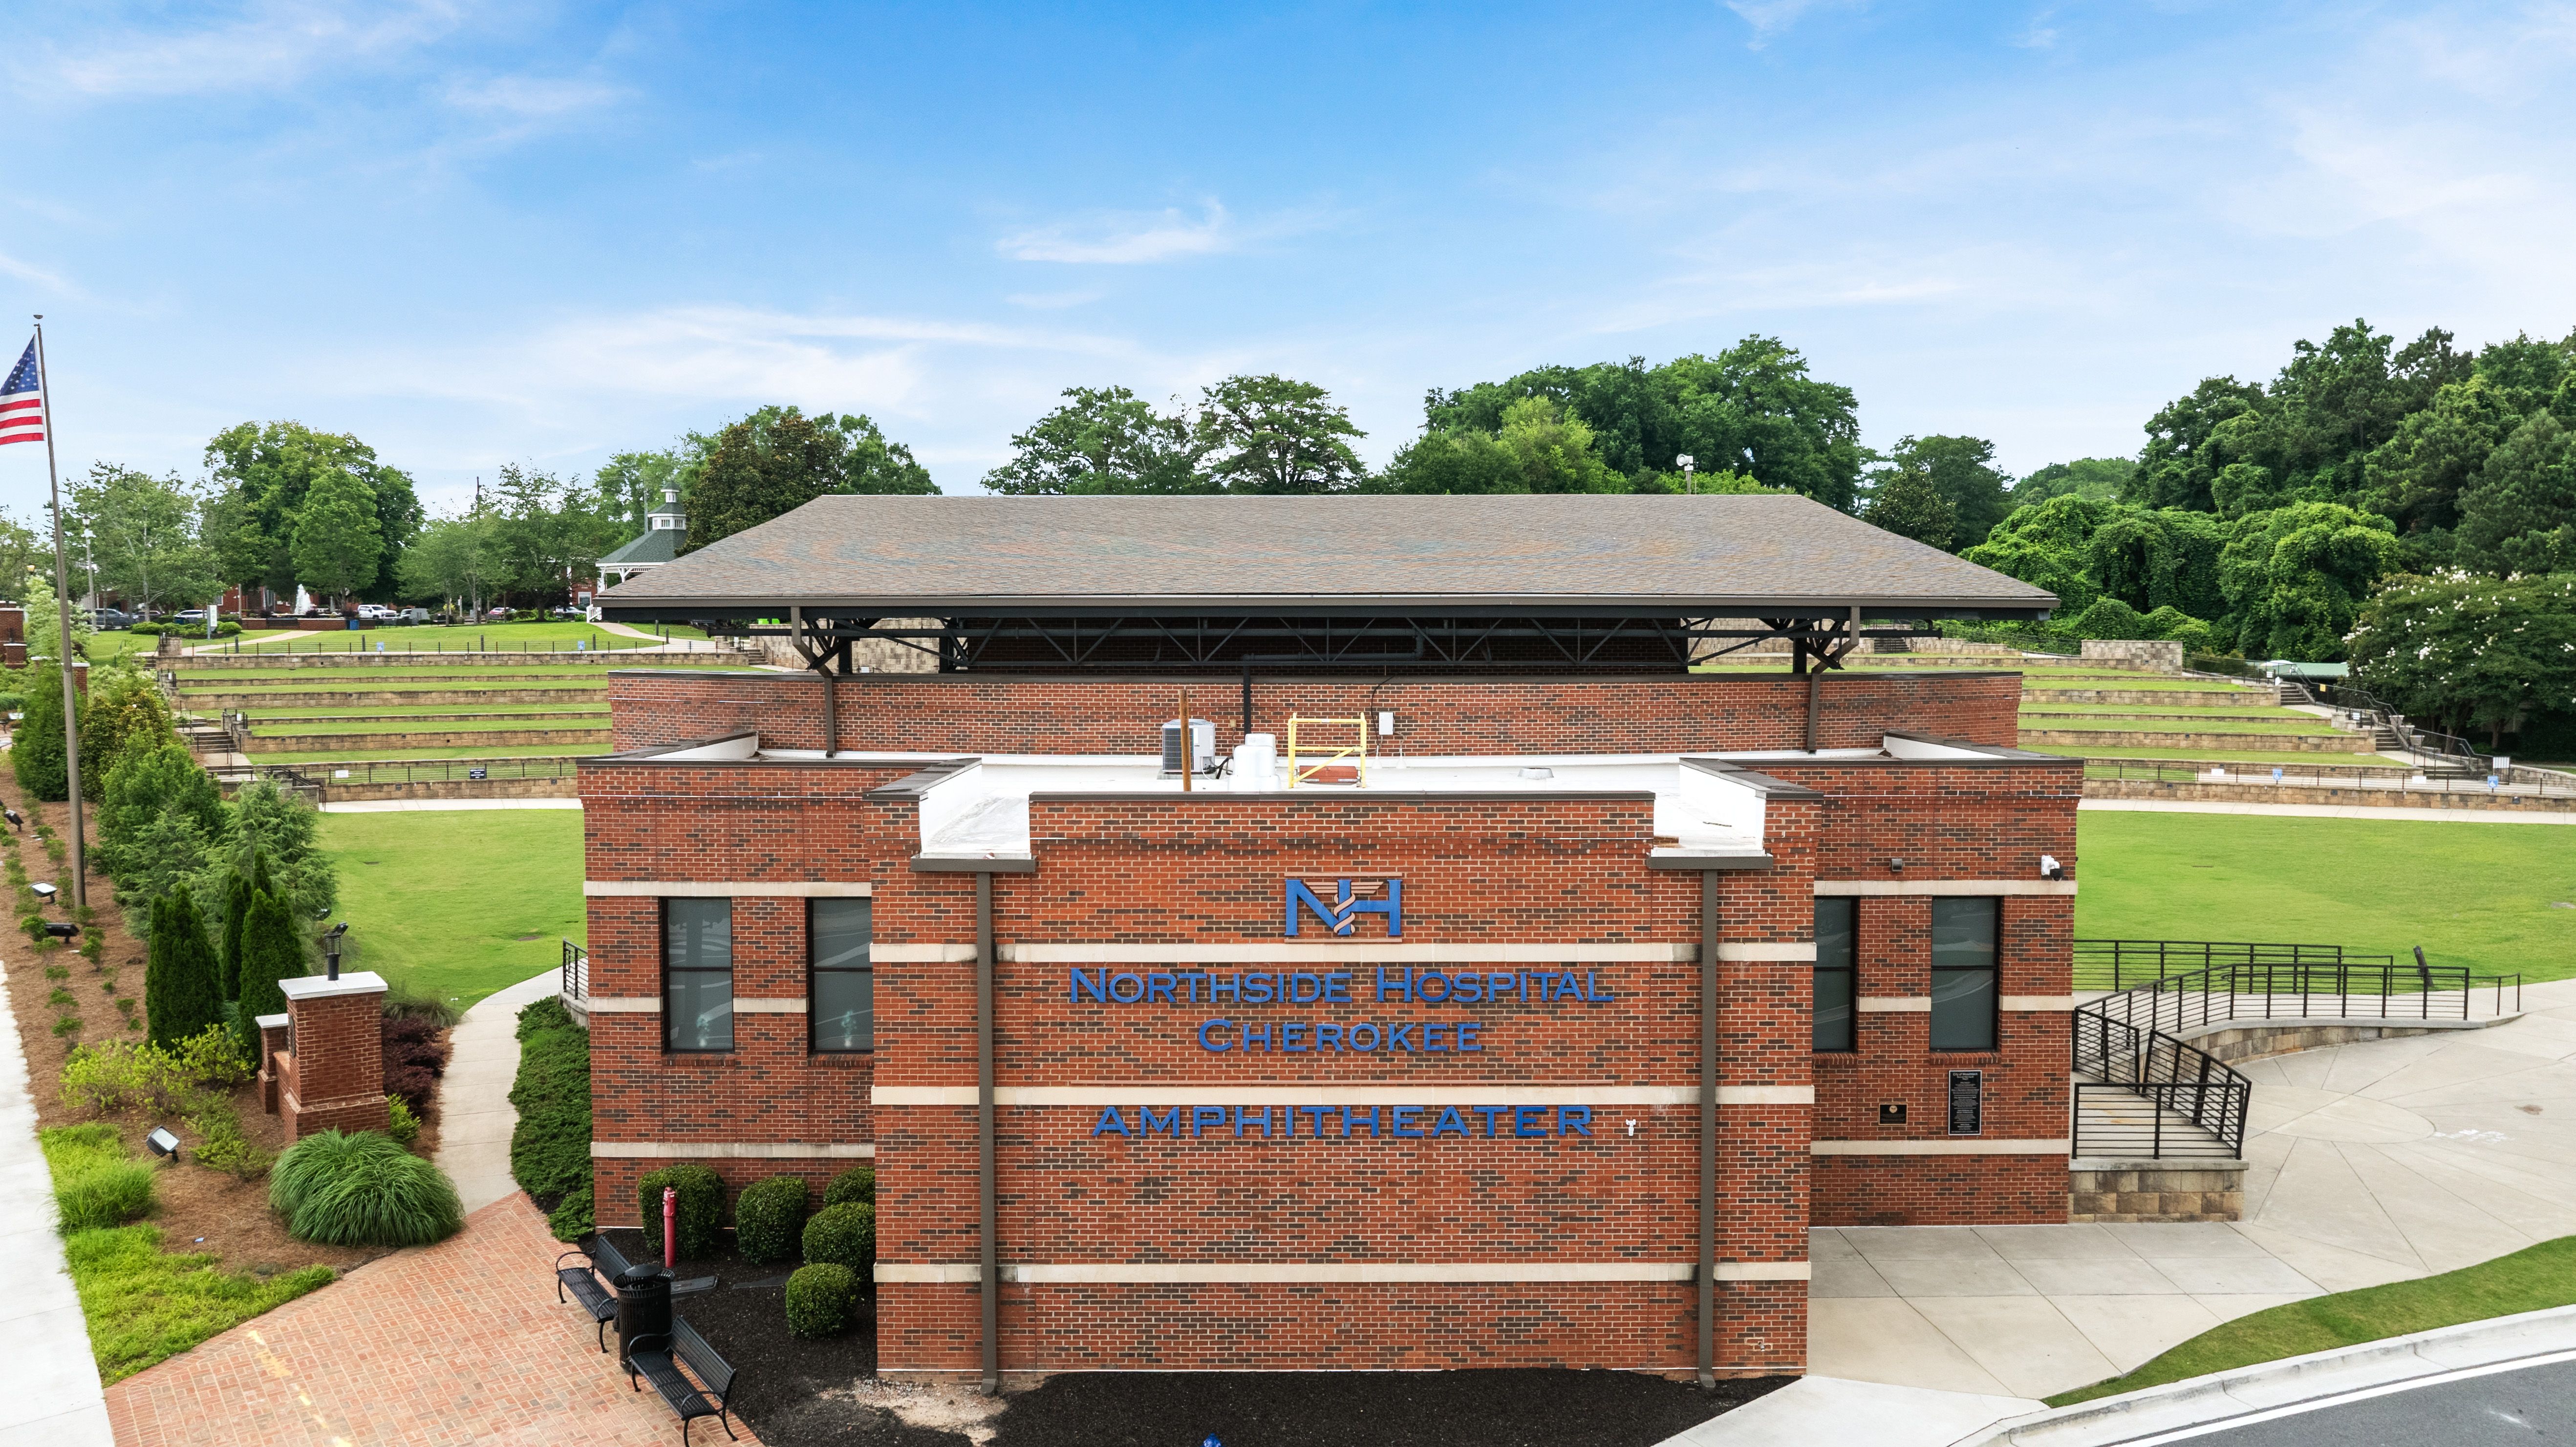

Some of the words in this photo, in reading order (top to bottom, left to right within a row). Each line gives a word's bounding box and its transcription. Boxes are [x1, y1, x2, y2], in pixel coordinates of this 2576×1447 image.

[1285, 879, 1402, 936] NH
[1070, 967, 1353, 1003] NORTHSIDE
[1376, 967, 1615, 1003] HOSPITAL
[1198, 1019, 1482, 1052] CHEROKEE
[1092, 1105, 1593, 1138] AMPHITHEATER
